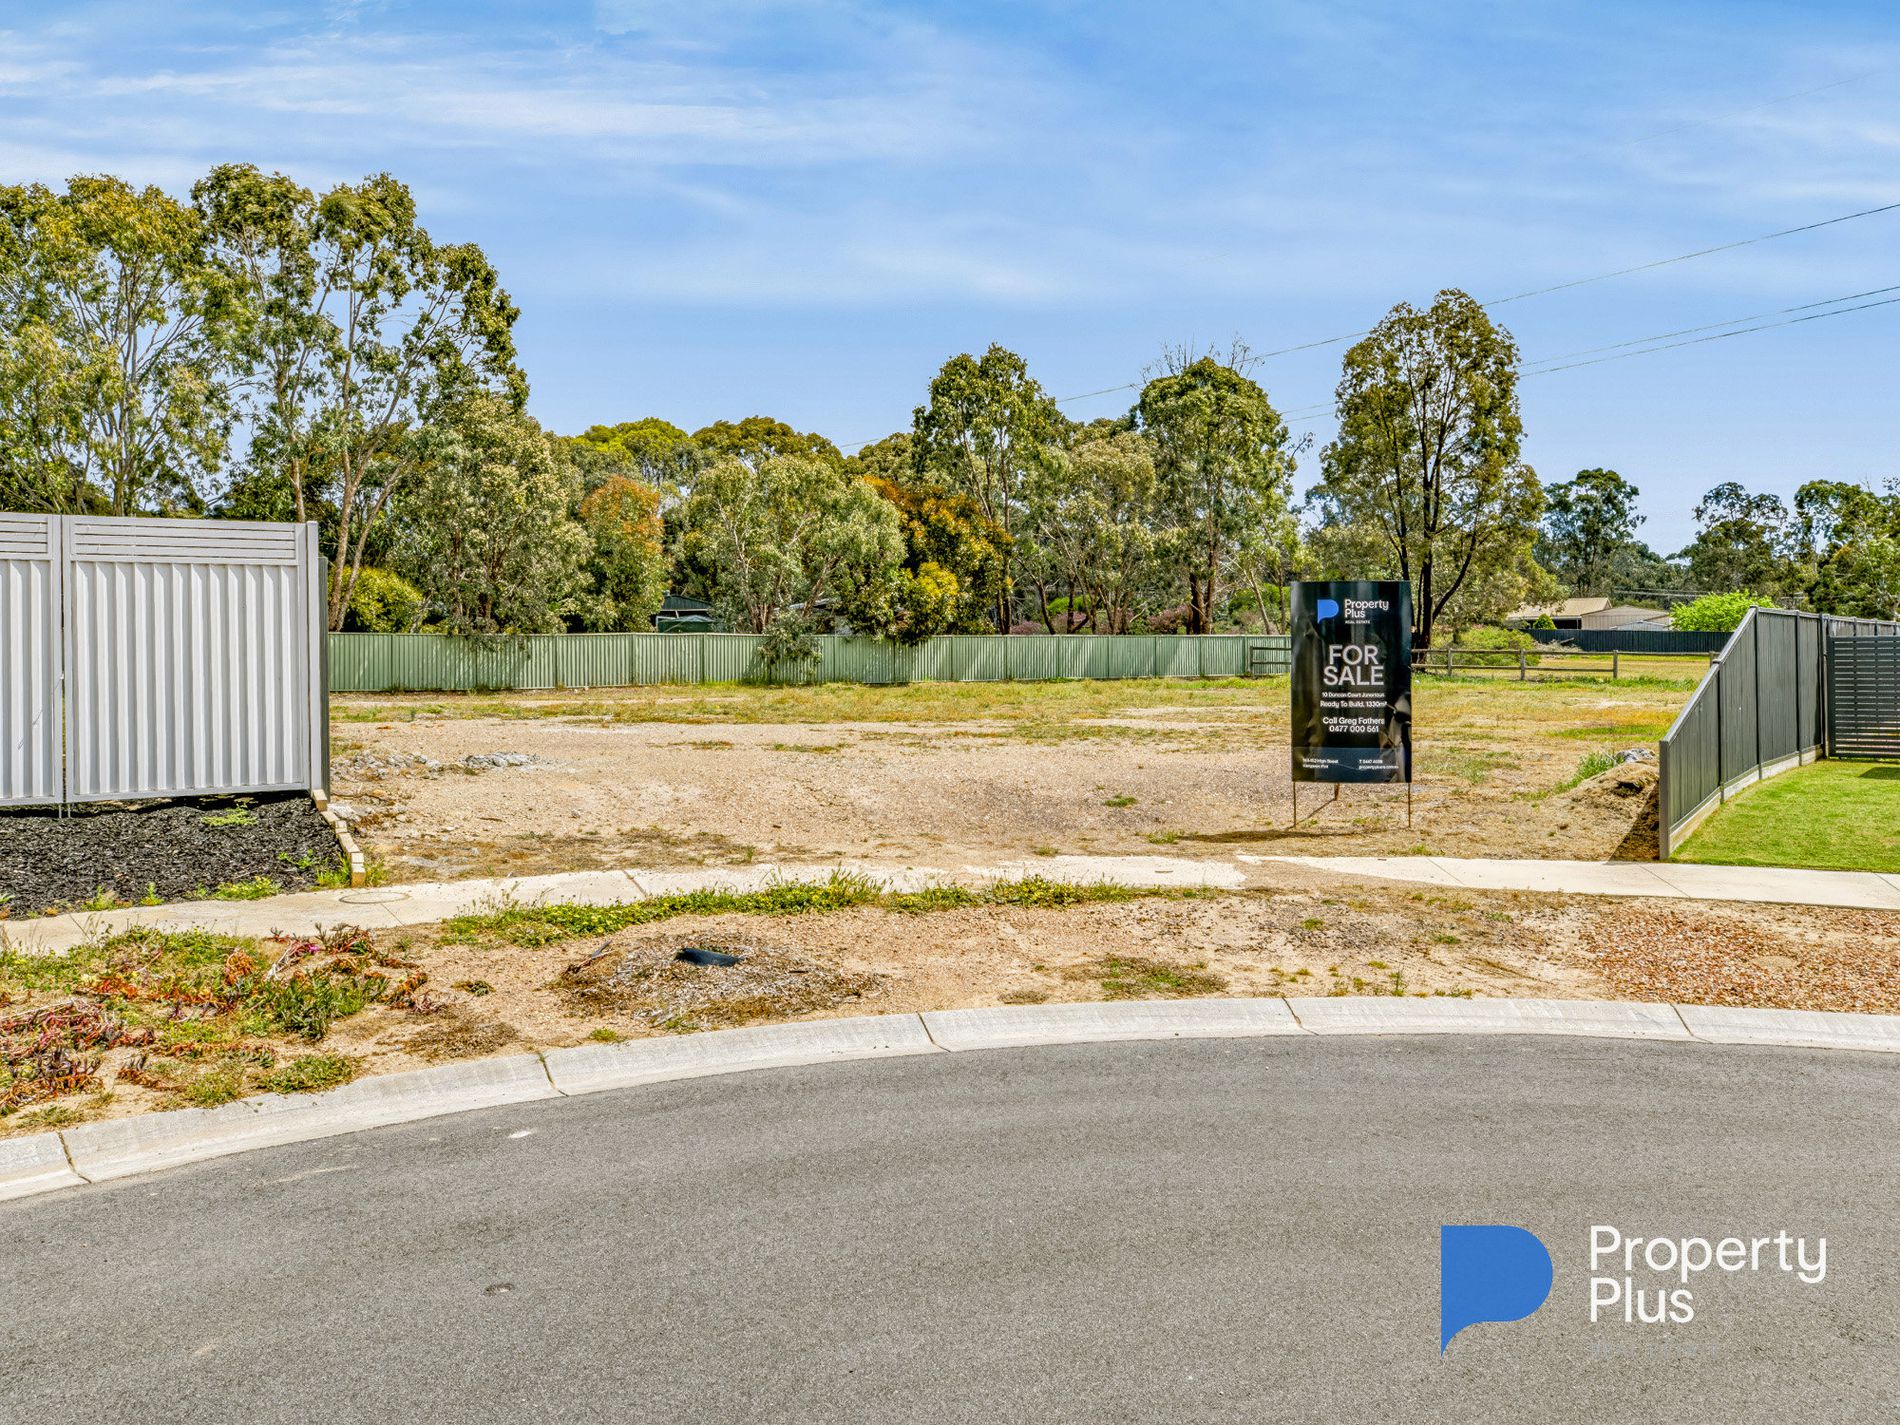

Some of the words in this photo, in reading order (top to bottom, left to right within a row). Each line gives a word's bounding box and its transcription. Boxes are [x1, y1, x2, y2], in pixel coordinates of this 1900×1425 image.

[1344, 599, 1389, 611] Property
[1344, 608, 1366, 618] Plus
[1329, 645, 1379, 665] FOR
[1323, 665, 1385, 686] SALE
[1322, 717, 1338, 725] Call
[1338, 717, 1357, 726] Greg
[1358, 717, 1385, 725] Fathers
